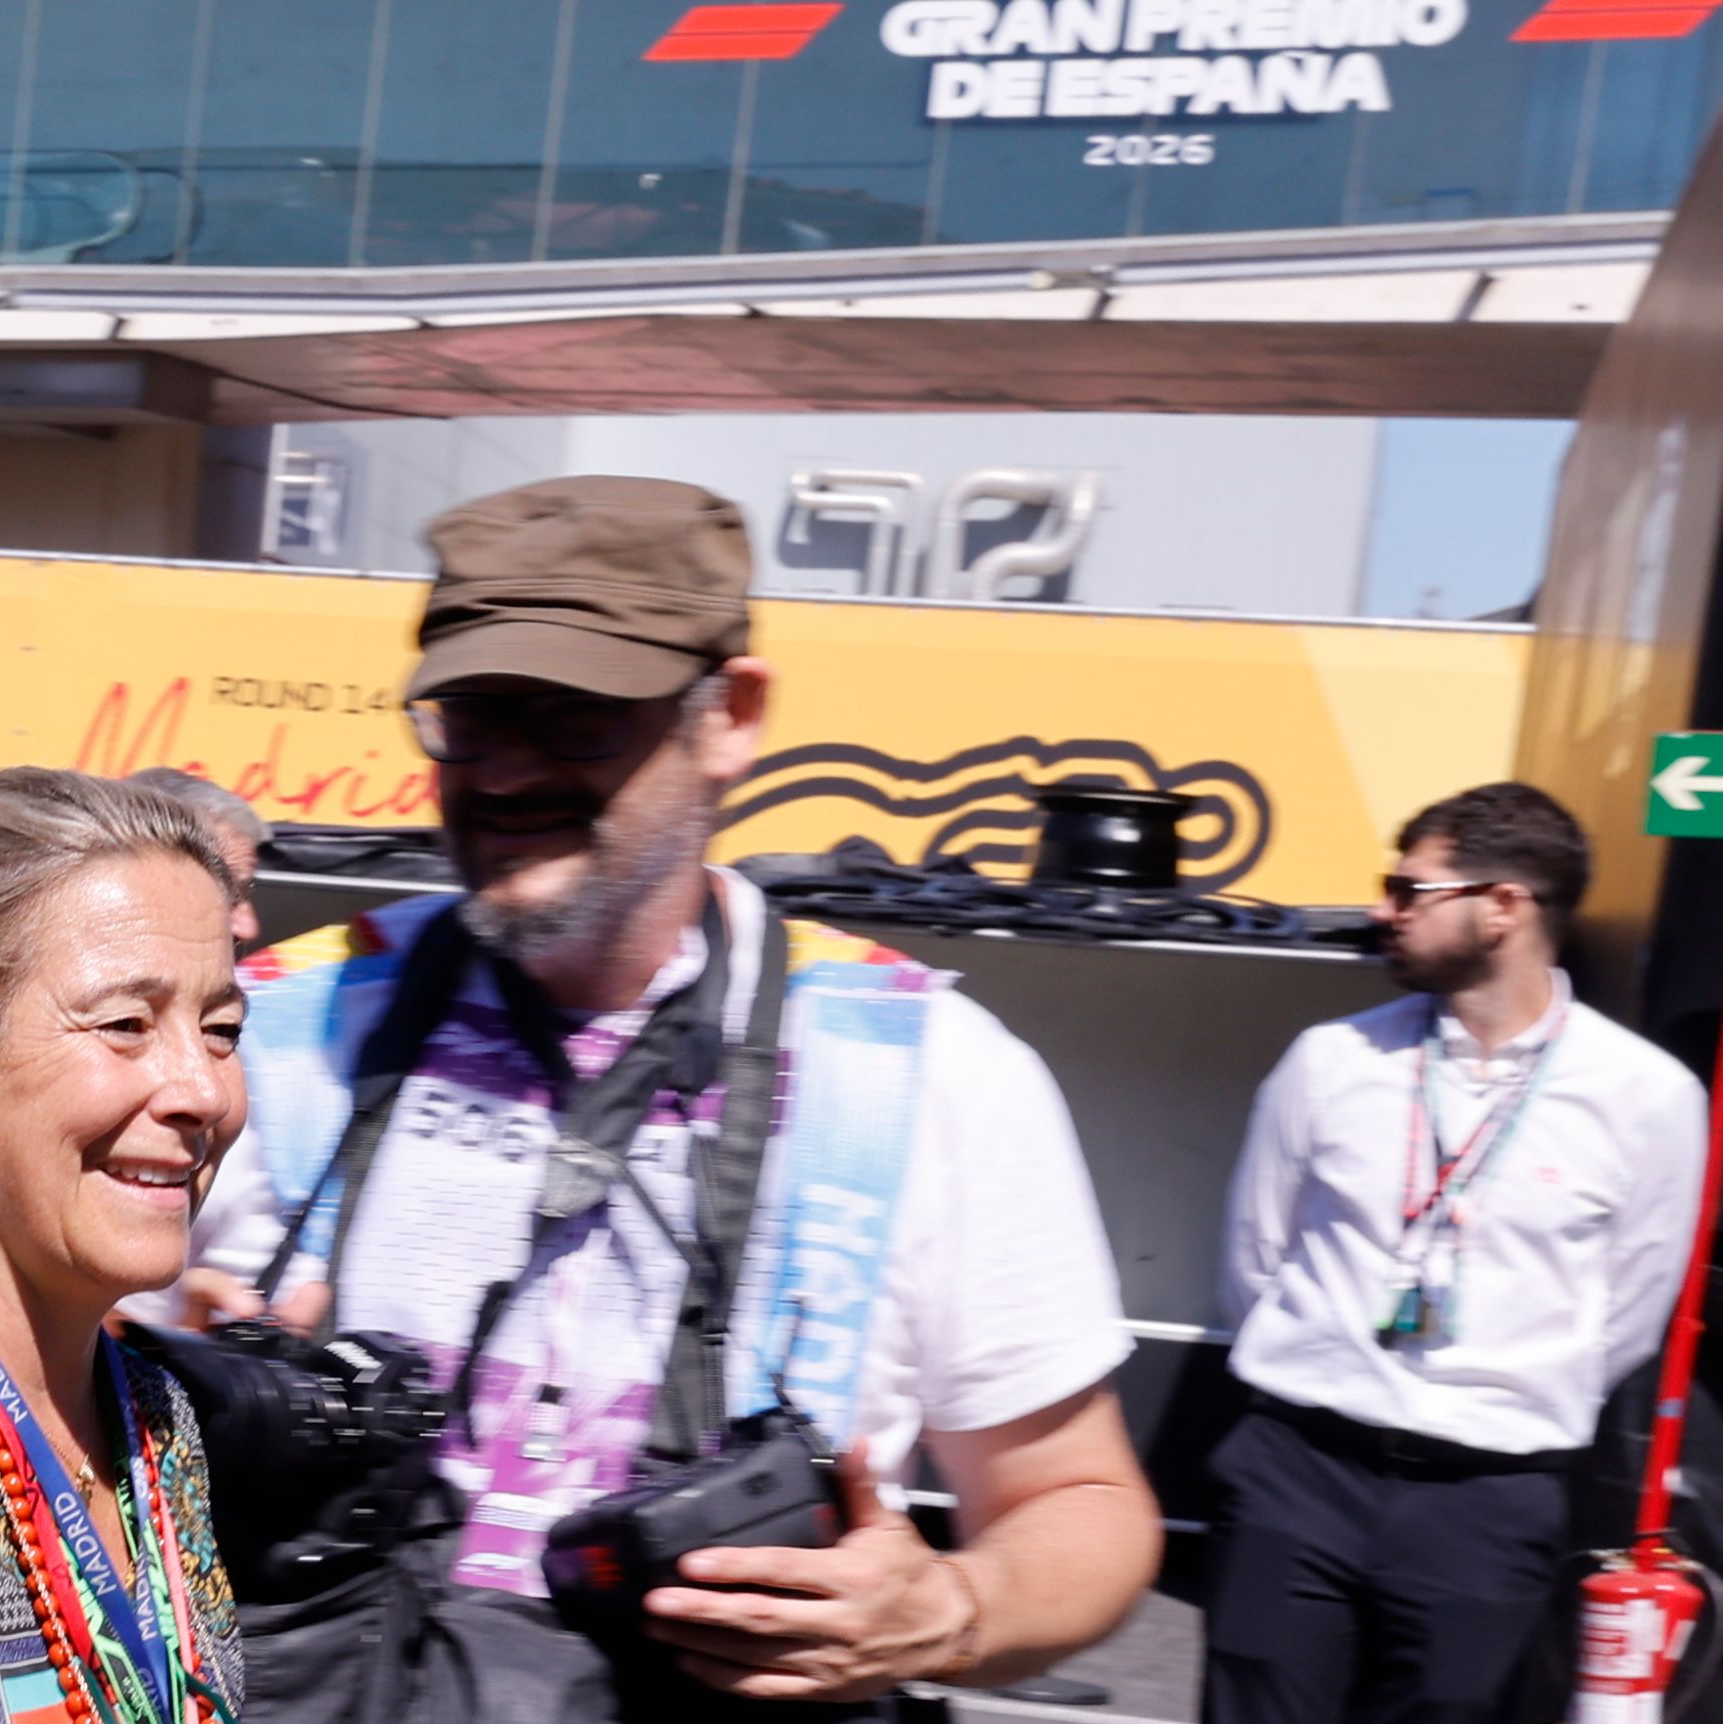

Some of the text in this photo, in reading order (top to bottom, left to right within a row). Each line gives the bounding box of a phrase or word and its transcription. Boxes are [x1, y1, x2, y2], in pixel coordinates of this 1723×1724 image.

[880, 0, 1466, 57] GRAN PREMIO
[925, 50, 1392, 118] DE ESPAÑA
[1082, 133, 1215, 166] 2026
[209, 675, 333, 713] ROUND
[54, 1491, 118, 1597] MADRID
